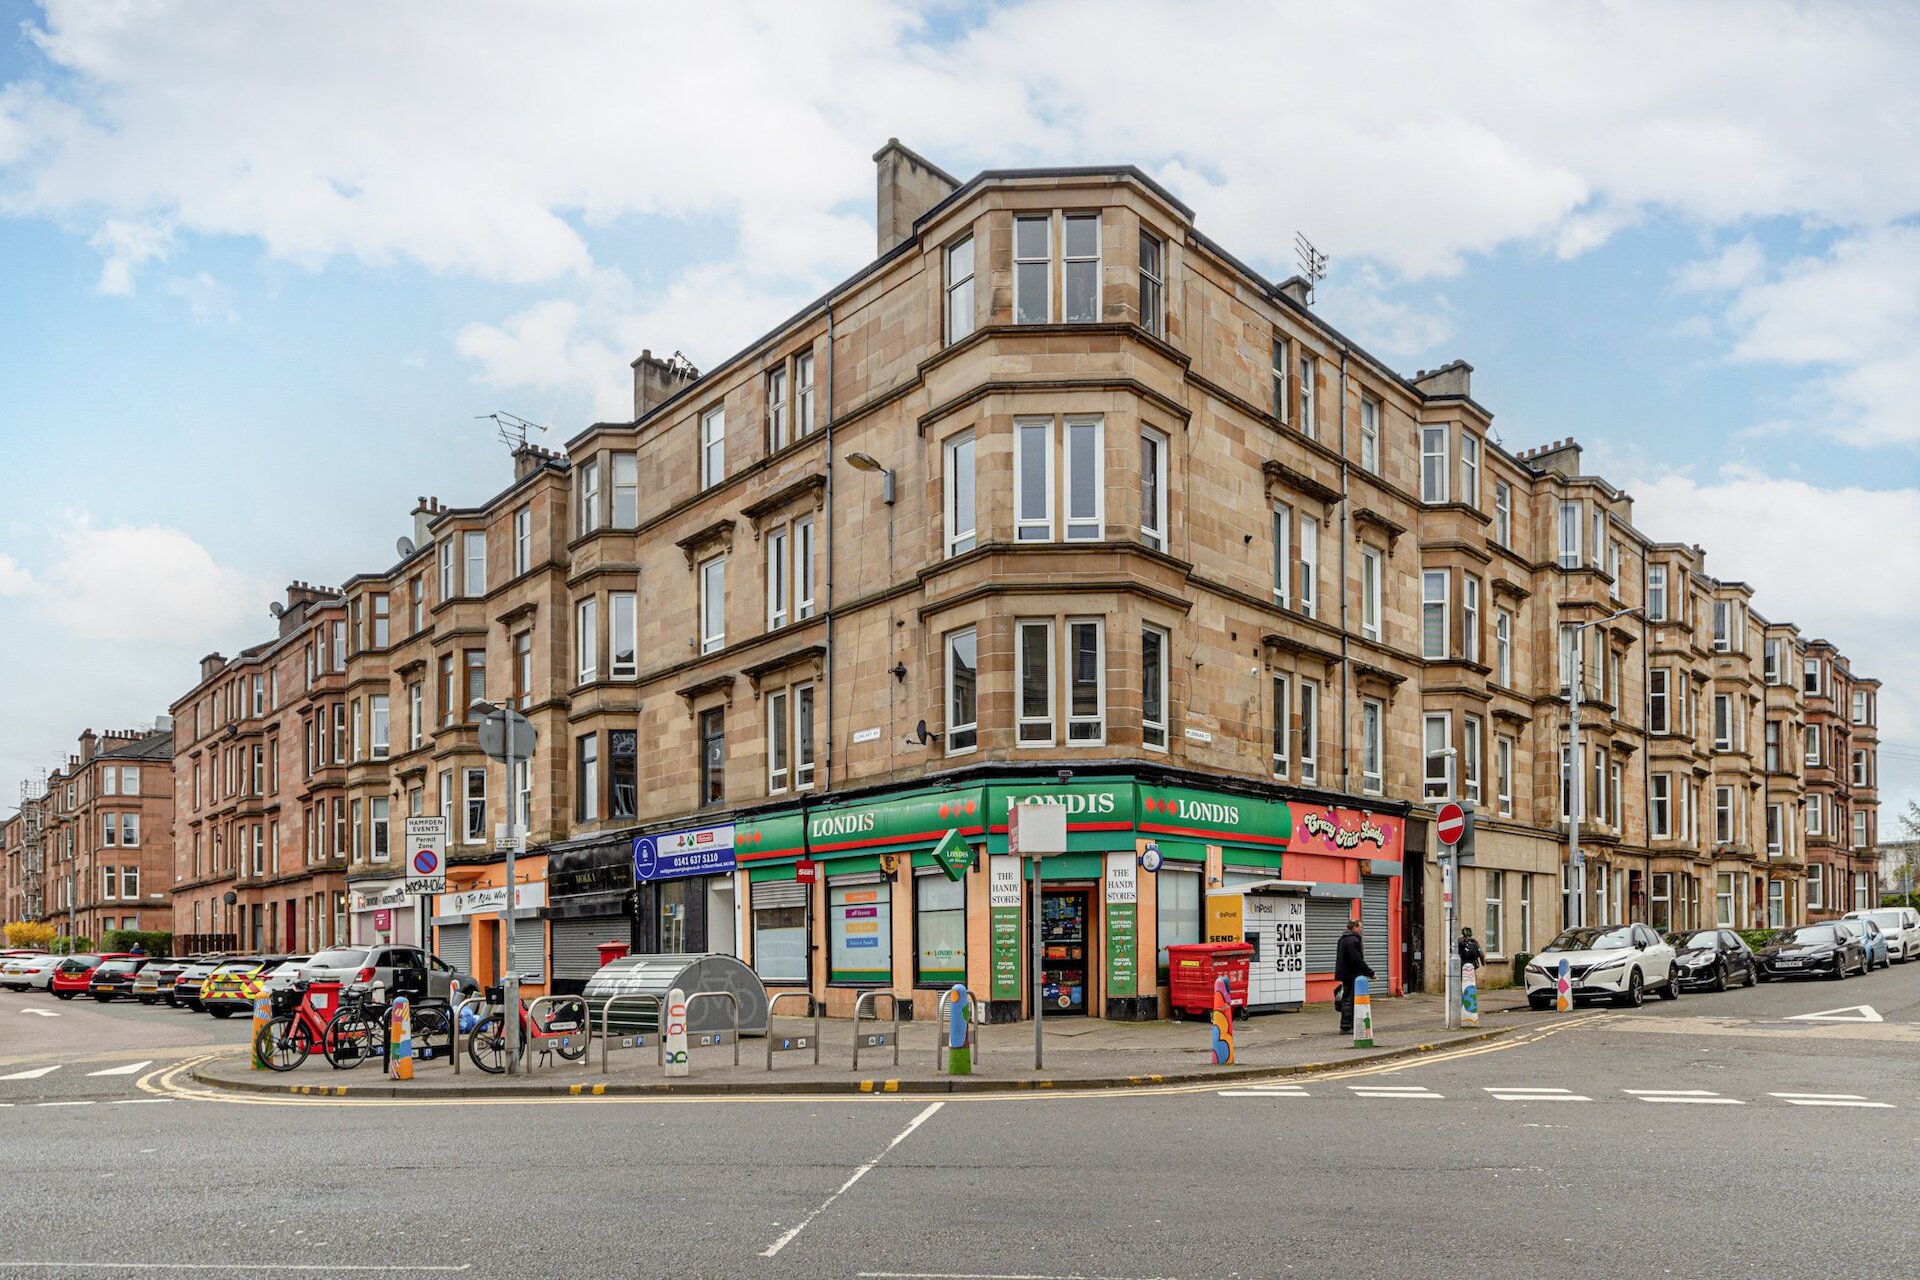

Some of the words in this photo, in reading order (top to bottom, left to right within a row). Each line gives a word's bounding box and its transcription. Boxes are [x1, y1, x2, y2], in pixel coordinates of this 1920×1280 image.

[1179, 799, 1239, 825] LONDIS
[813, 812, 874, 838] LONDIS
[1304, 813, 1336, 838] Crazy
[1336, 828, 1360, 848] Hair
[1361, 820, 1384, 847] Lady
[674, 856, 688, 866] 0141
[690, 854, 701, 865] 637
[702, 853, 718, 863] 5110
[467, 894, 476, 903] THE
[480, 893, 492, 903] REAL
[1254, 903, 1273, 913] InPost
[1290, 903, 1302, 915] 24/7
[1276, 923, 1302, 941] SCAN
[1276, 944, 1302, 957] TAP
